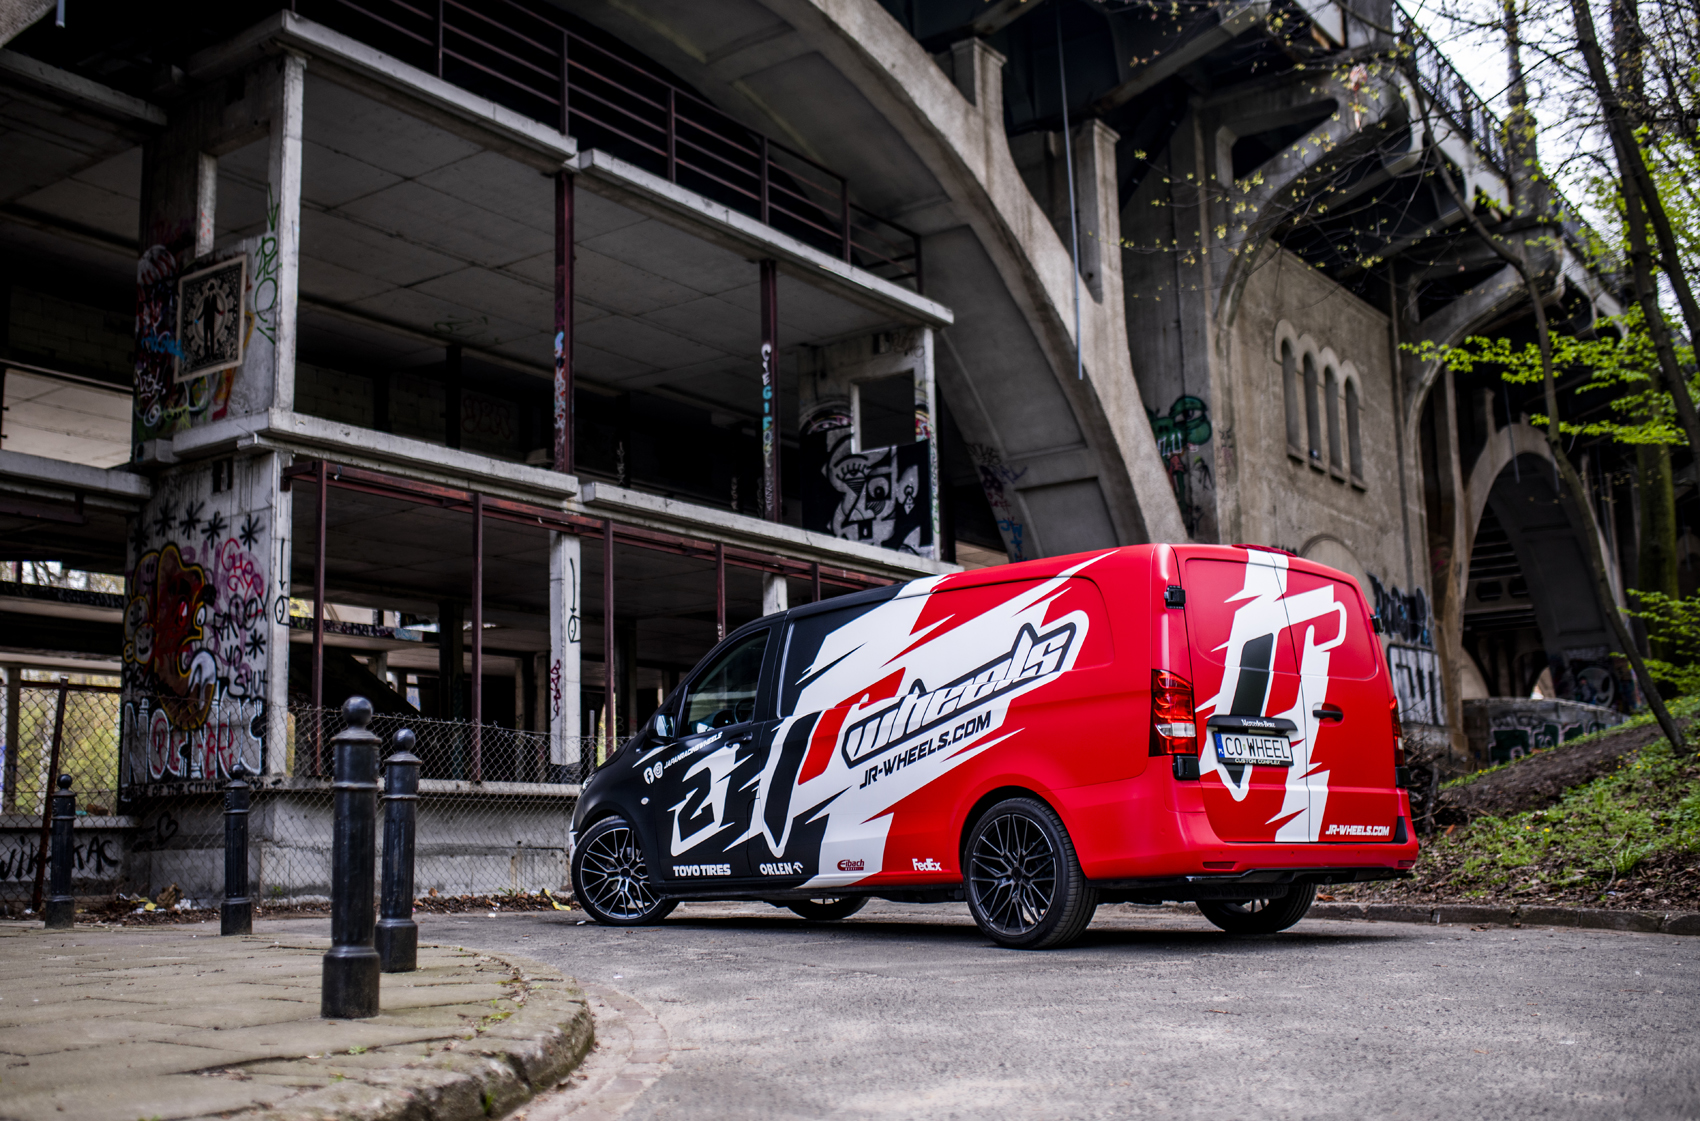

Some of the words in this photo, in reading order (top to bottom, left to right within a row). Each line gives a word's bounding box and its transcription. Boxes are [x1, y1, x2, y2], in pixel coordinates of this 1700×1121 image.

[842, 622, 1077, 769] wheels
[1241, 719, 1276, 728] Mercedes-Benz
[859, 711, 991, 789] JR-WHEELS.COM
[1246, 737, 1290, 759] WHEEL
[1325, 824, 1390, 837] JR-WHEELS.COM
[672, 865, 700, 877] TOYO
[700, 863, 732, 876] TIRES
[759, 862, 794, 876] ORLEN
[837, 858, 864, 872] Eibach
[912, 858, 942, 871] FedEx
